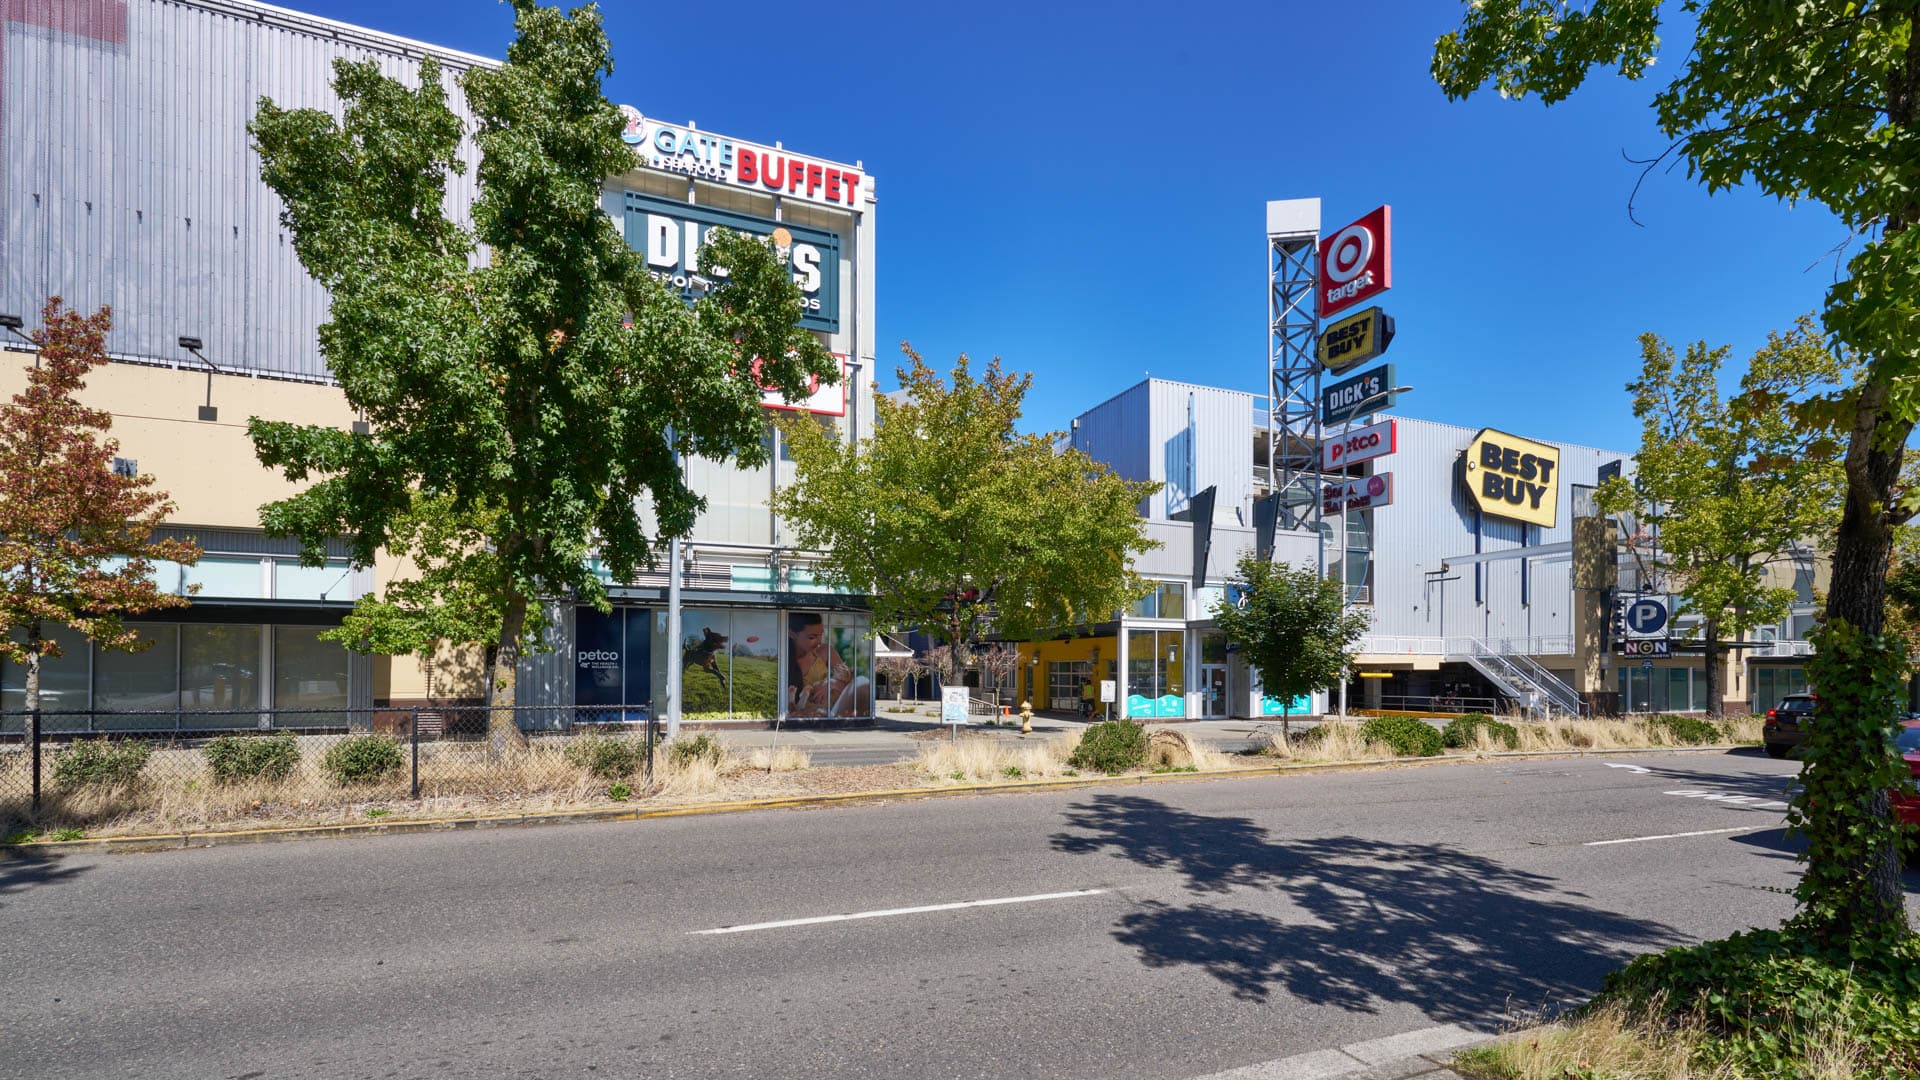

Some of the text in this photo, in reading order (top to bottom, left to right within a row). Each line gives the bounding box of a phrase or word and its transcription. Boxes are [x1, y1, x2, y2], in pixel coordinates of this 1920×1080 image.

[654, 127, 860, 205] GATE BUFFET
[663, 156, 728, 181] SEAFOOD
[648, 214, 821, 292] DI'S
[1327, 270, 1374, 304] target
[1327, 317, 1371, 346] BEST
[1328, 333, 1366, 359] BUY
[1330, 377, 1379, 410] DICK'S
[1331, 432, 1381, 462] petco
[1480, 441, 1554, 484] BEST
[1482, 471, 1548, 510] BUY
[1635, 604, 1658, 629] P
[578, 649, 619, 663] petco
[1626, 641, 1667, 655] NGN
